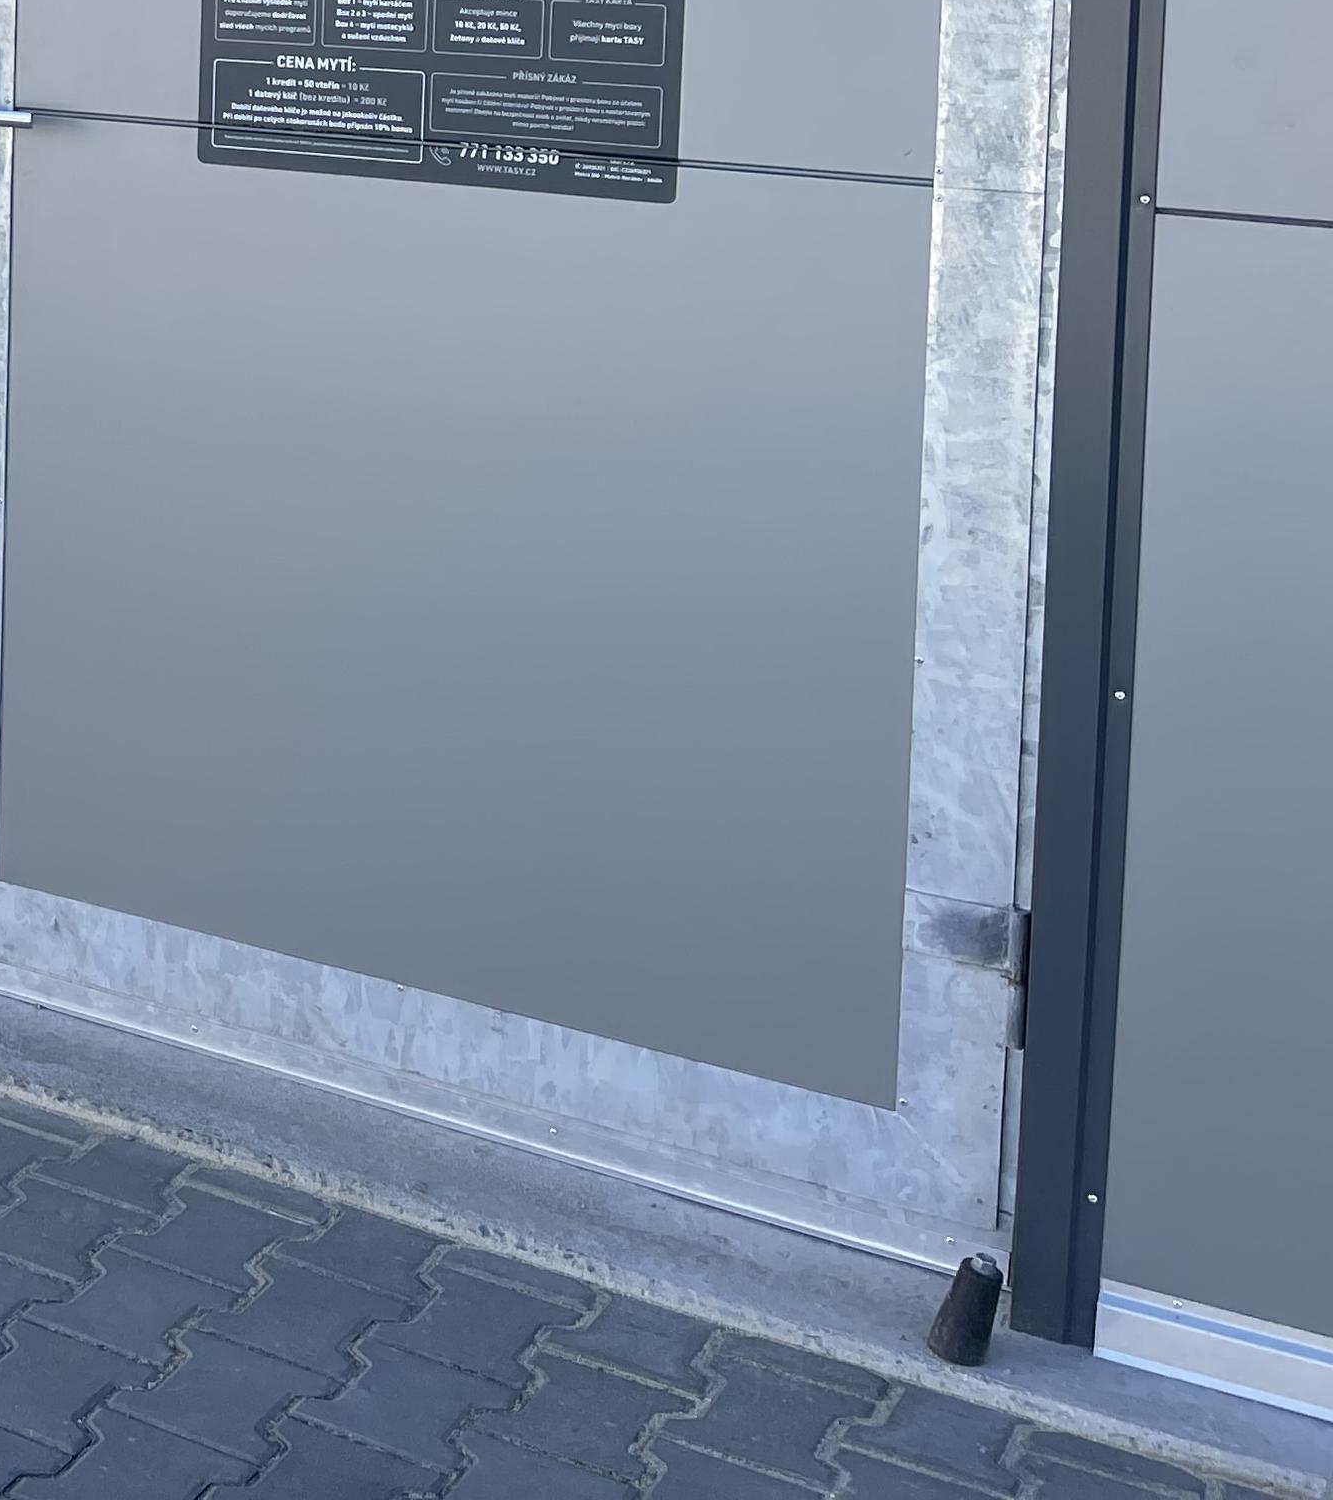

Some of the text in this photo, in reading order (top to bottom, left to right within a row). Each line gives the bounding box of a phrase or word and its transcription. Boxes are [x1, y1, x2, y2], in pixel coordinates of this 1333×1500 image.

[277, 55, 357, 73] CENA MYTÍ:
[266, 78, 270, 86] 1
[272, 77, 296, 87] kredit
[304, 79, 314, 88] 50
[315, 79, 340, 90] vteřin
[348, 82, 358, 91] 10
[359, 82, 370, 91] Kč
[248, 89, 252, 97] 1
[254, 89, 284, 101] datový
[285, 90, 297, 101] klíč
[299, 92, 317, 102] (bez
[318, 94, 351, 105] kreditu)
[360, 97, 375, 106] 200
[377, 97, 387, 107] Kč
[459, 141, 489, 160] 771
[476, 164, 537, 177] WWW.TASY.CZ
